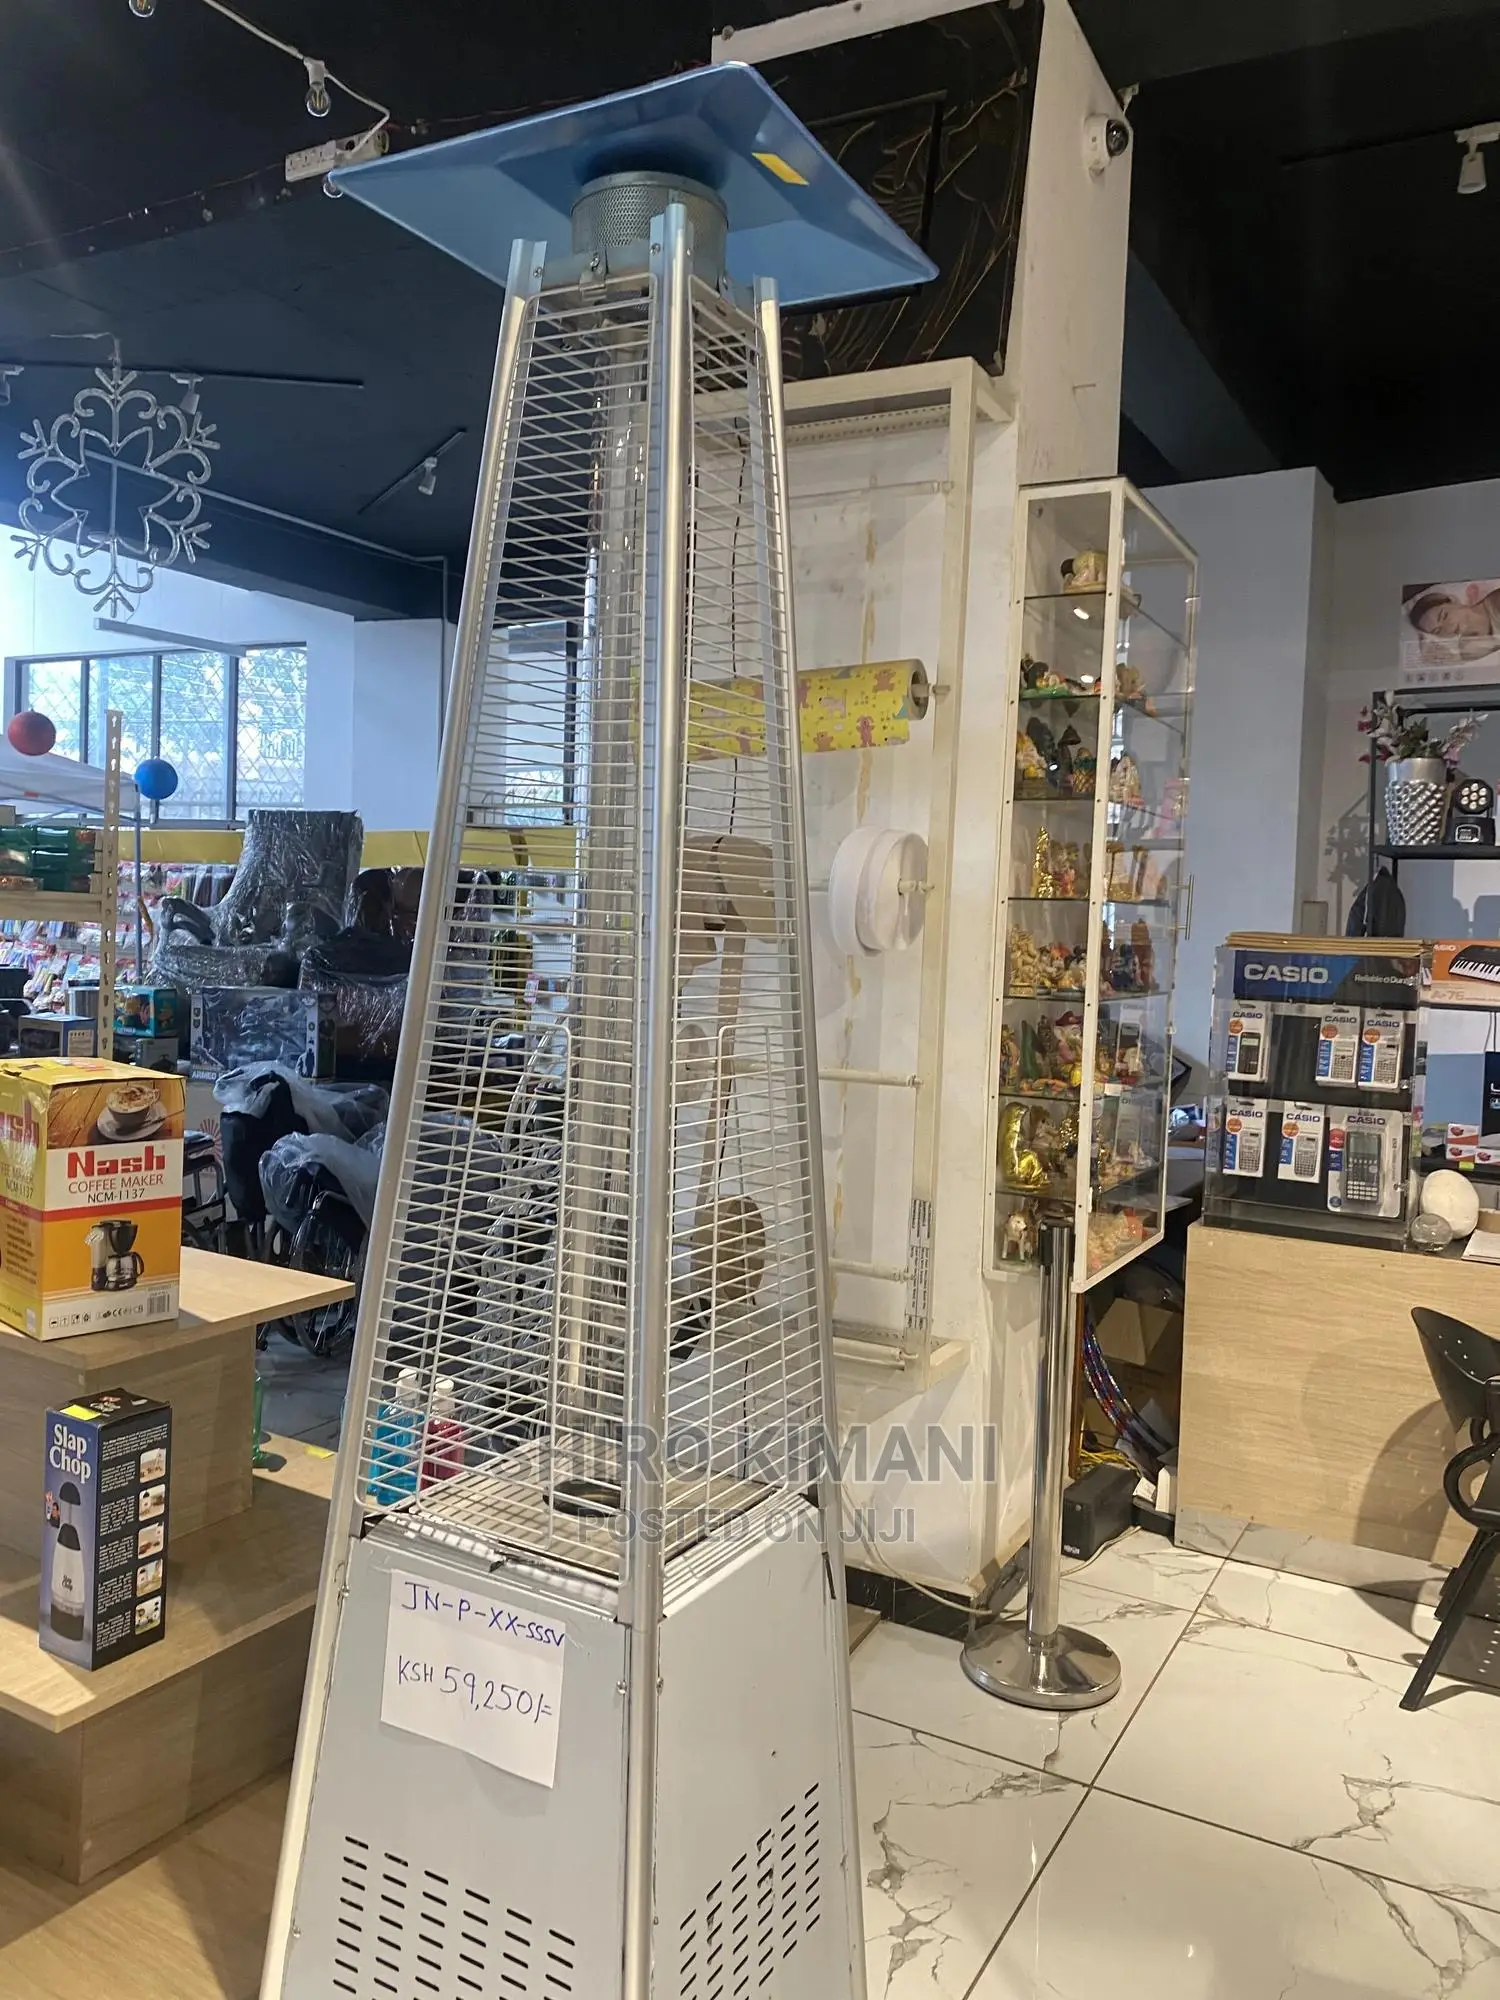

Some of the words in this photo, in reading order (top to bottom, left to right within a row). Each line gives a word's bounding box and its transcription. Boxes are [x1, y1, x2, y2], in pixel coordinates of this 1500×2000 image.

[1433, 943, 1457, 952] ASIO
[1243, 963, 1330, 984] CASIO
[1232, 1010, 1263, 1019] CASIO
[1324, 1015, 1357, 1024] CASIO
[1366, 1019, 1400, 1028] CASIO
[191, 1070, 217, 1080] ARMED
[1229, 1109, 1263, 1118] CASIO
[1286, 1113, 1321, 1123] CASIO
[1347, 1115, 1386, 1126] CASIO
[67, 1145, 166, 1179] Nash
[68, 1177, 117, 1194] COFFEE
[120, 1173, 164, 1189] MAKER
[87, 1187, 146, 1204] NCM-1137
[53, 1423, 88, 1460] Slap
[49, 1445, 92, 1484] Chop
[398, 1654, 434, 1685] KSH
[439, 1665, 553, 1724] 59,250/=
